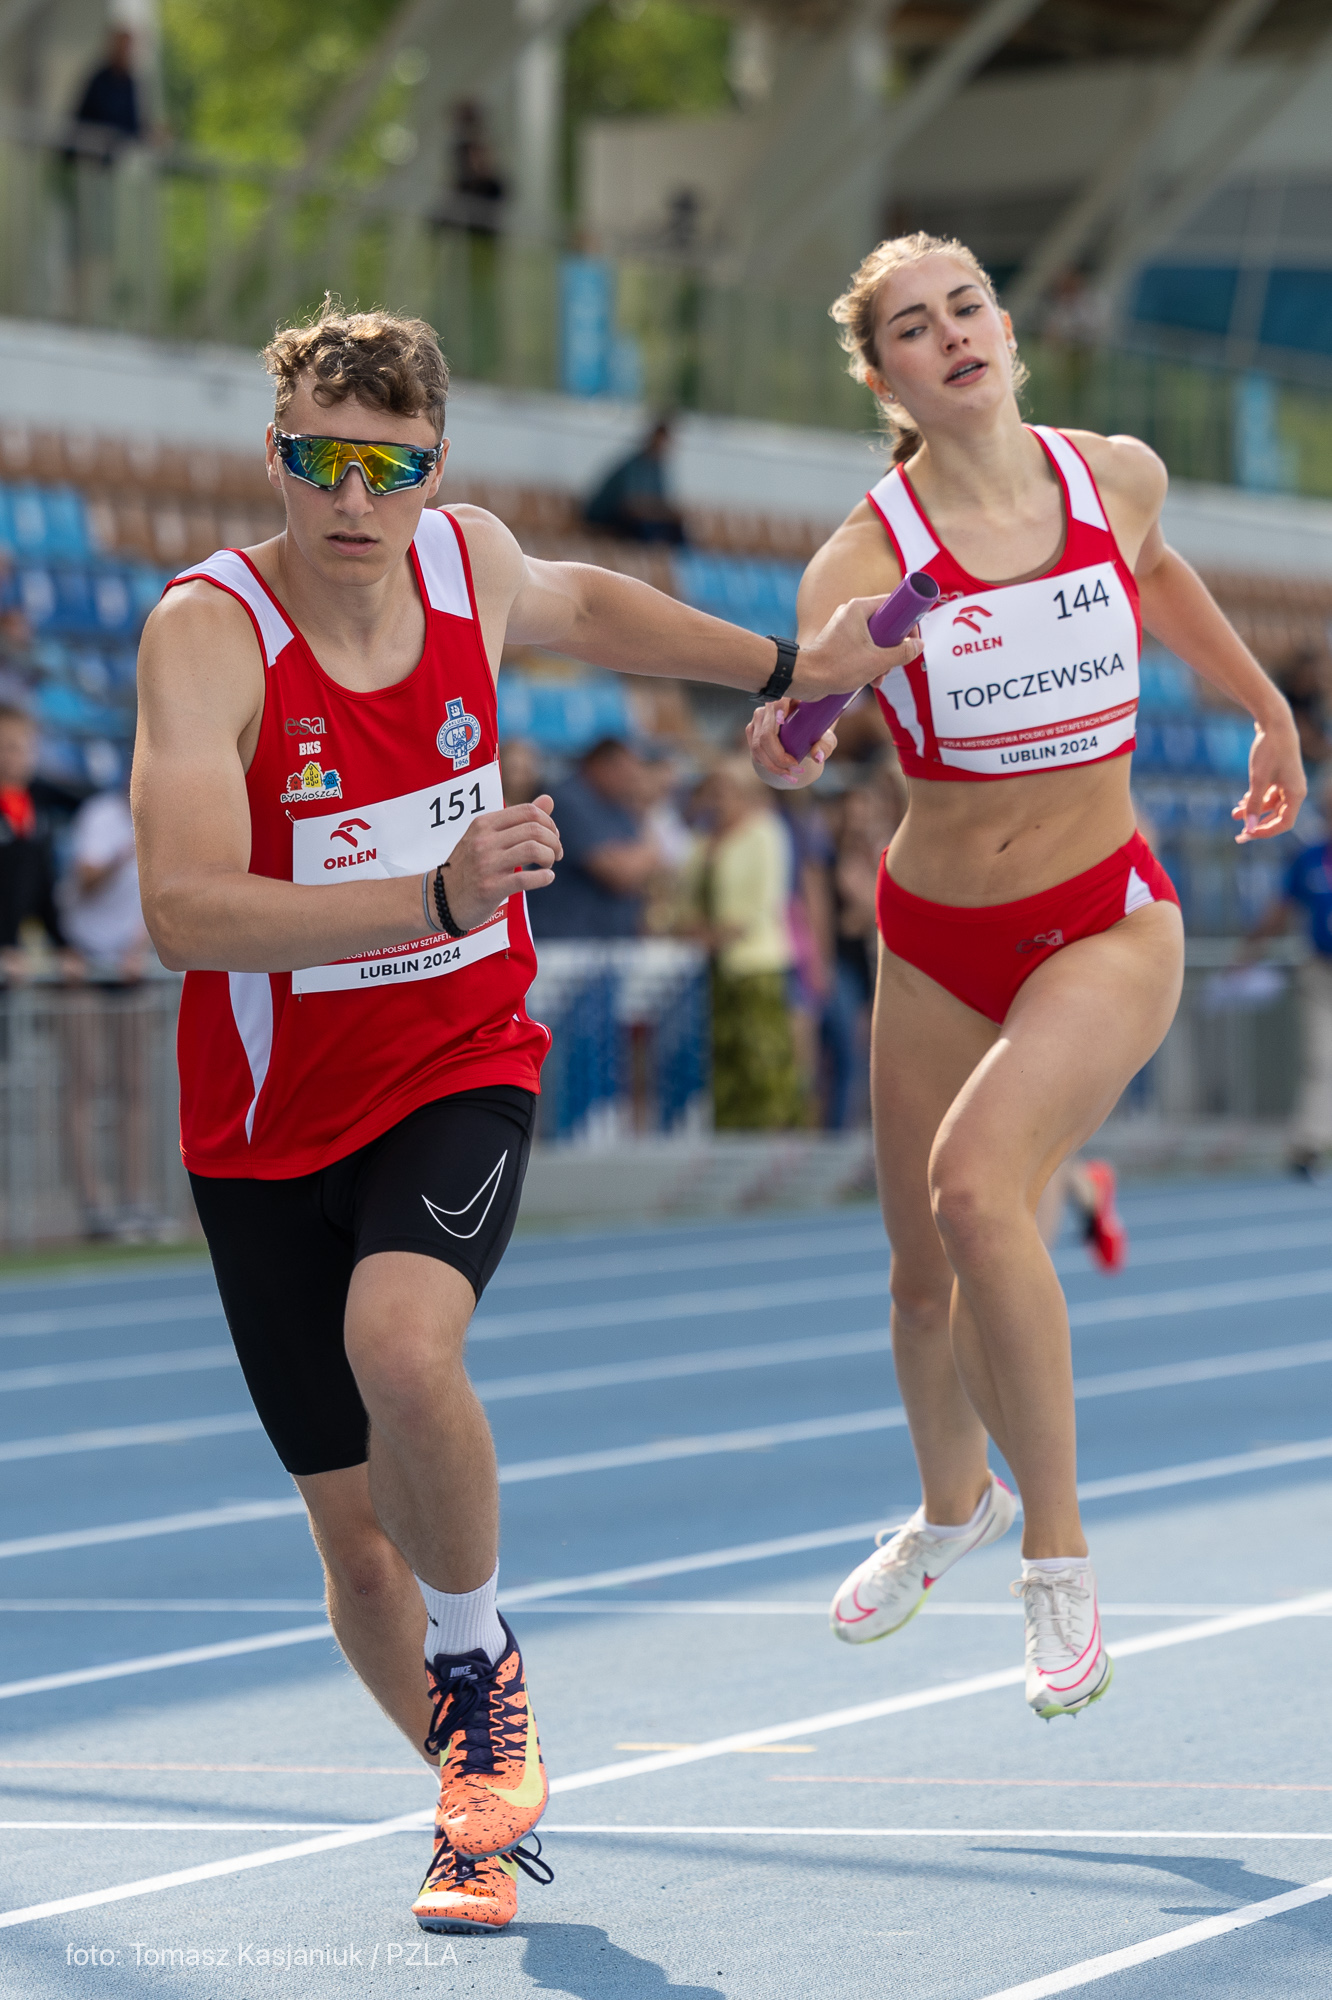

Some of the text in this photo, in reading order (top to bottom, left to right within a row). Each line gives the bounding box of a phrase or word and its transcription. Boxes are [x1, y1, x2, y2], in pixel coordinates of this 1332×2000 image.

[1053, 579, 1110, 620] 144
[952, 636, 1003, 656] ORLEN
[947, 653, 1125, 711] TOPCZEWSKA
[962, 735, 1018, 748] MISTRZOSTWA
[1019, 730, 1046, 741] POLSKI
[1045, 728, 1055, 737] W
[1055, 717, 1100, 735] SZTAFETACH
[299, 740, 322, 756] BKS
[1001, 735, 1099, 765] LUBLIN 2024
[455, 758, 469, 769] 1956
[281, 789, 338, 802] BYDGOSZCZ
[429, 782, 486, 829] 151
[323, 848, 377, 870] ORLEN
[382, 943, 410, 955] POLSKI
[410, 941, 420, 950] W
[360, 946, 461, 980] LUBLIN 2024
[450, 1664, 472, 1678] NIKE
